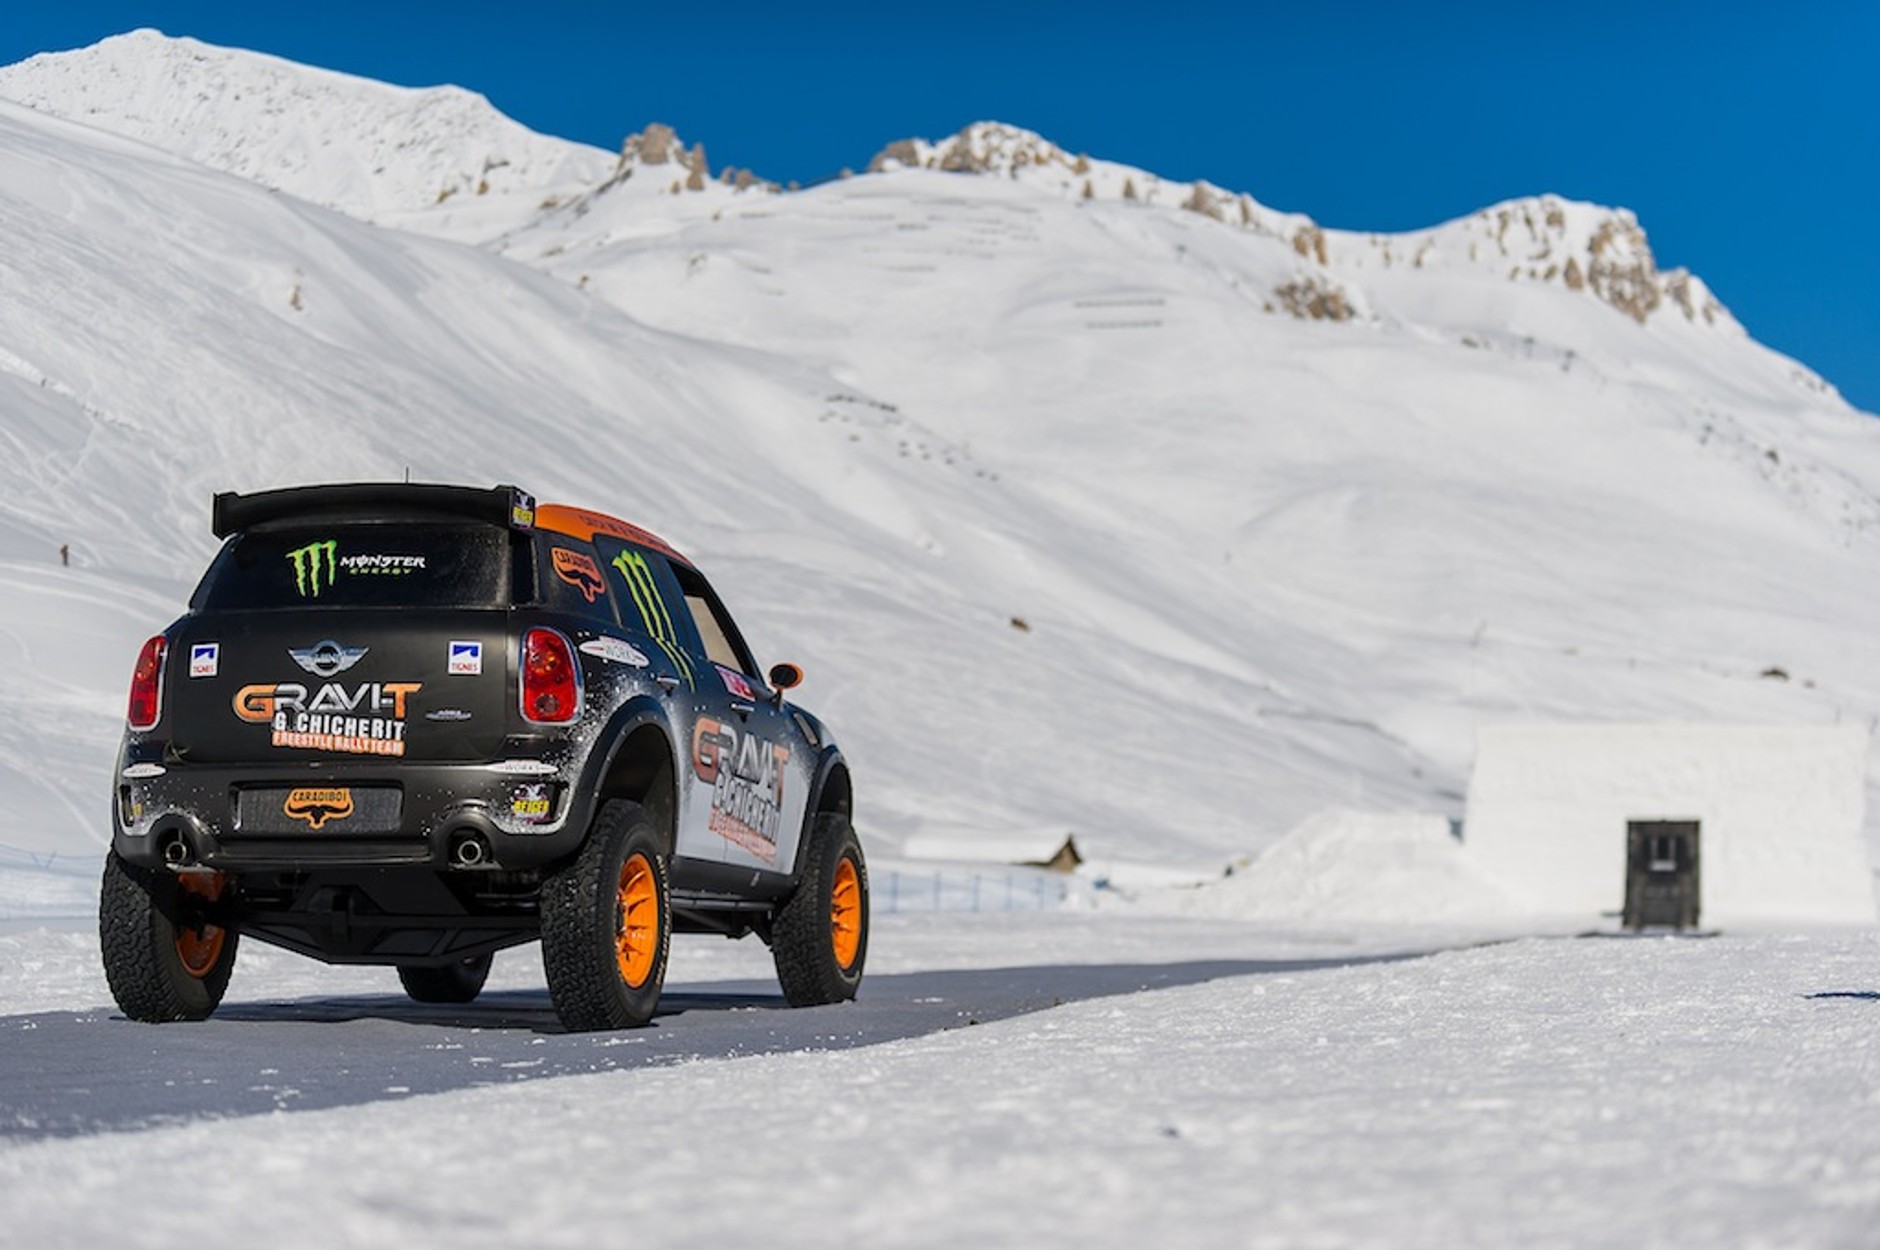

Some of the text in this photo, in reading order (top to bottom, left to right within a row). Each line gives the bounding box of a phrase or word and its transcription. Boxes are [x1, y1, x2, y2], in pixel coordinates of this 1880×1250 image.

[340, 554, 426, 568] MONSTER
[452, 662, 478, 671] TIGNES
[297, 713, 406, 740] CHICHERIT
